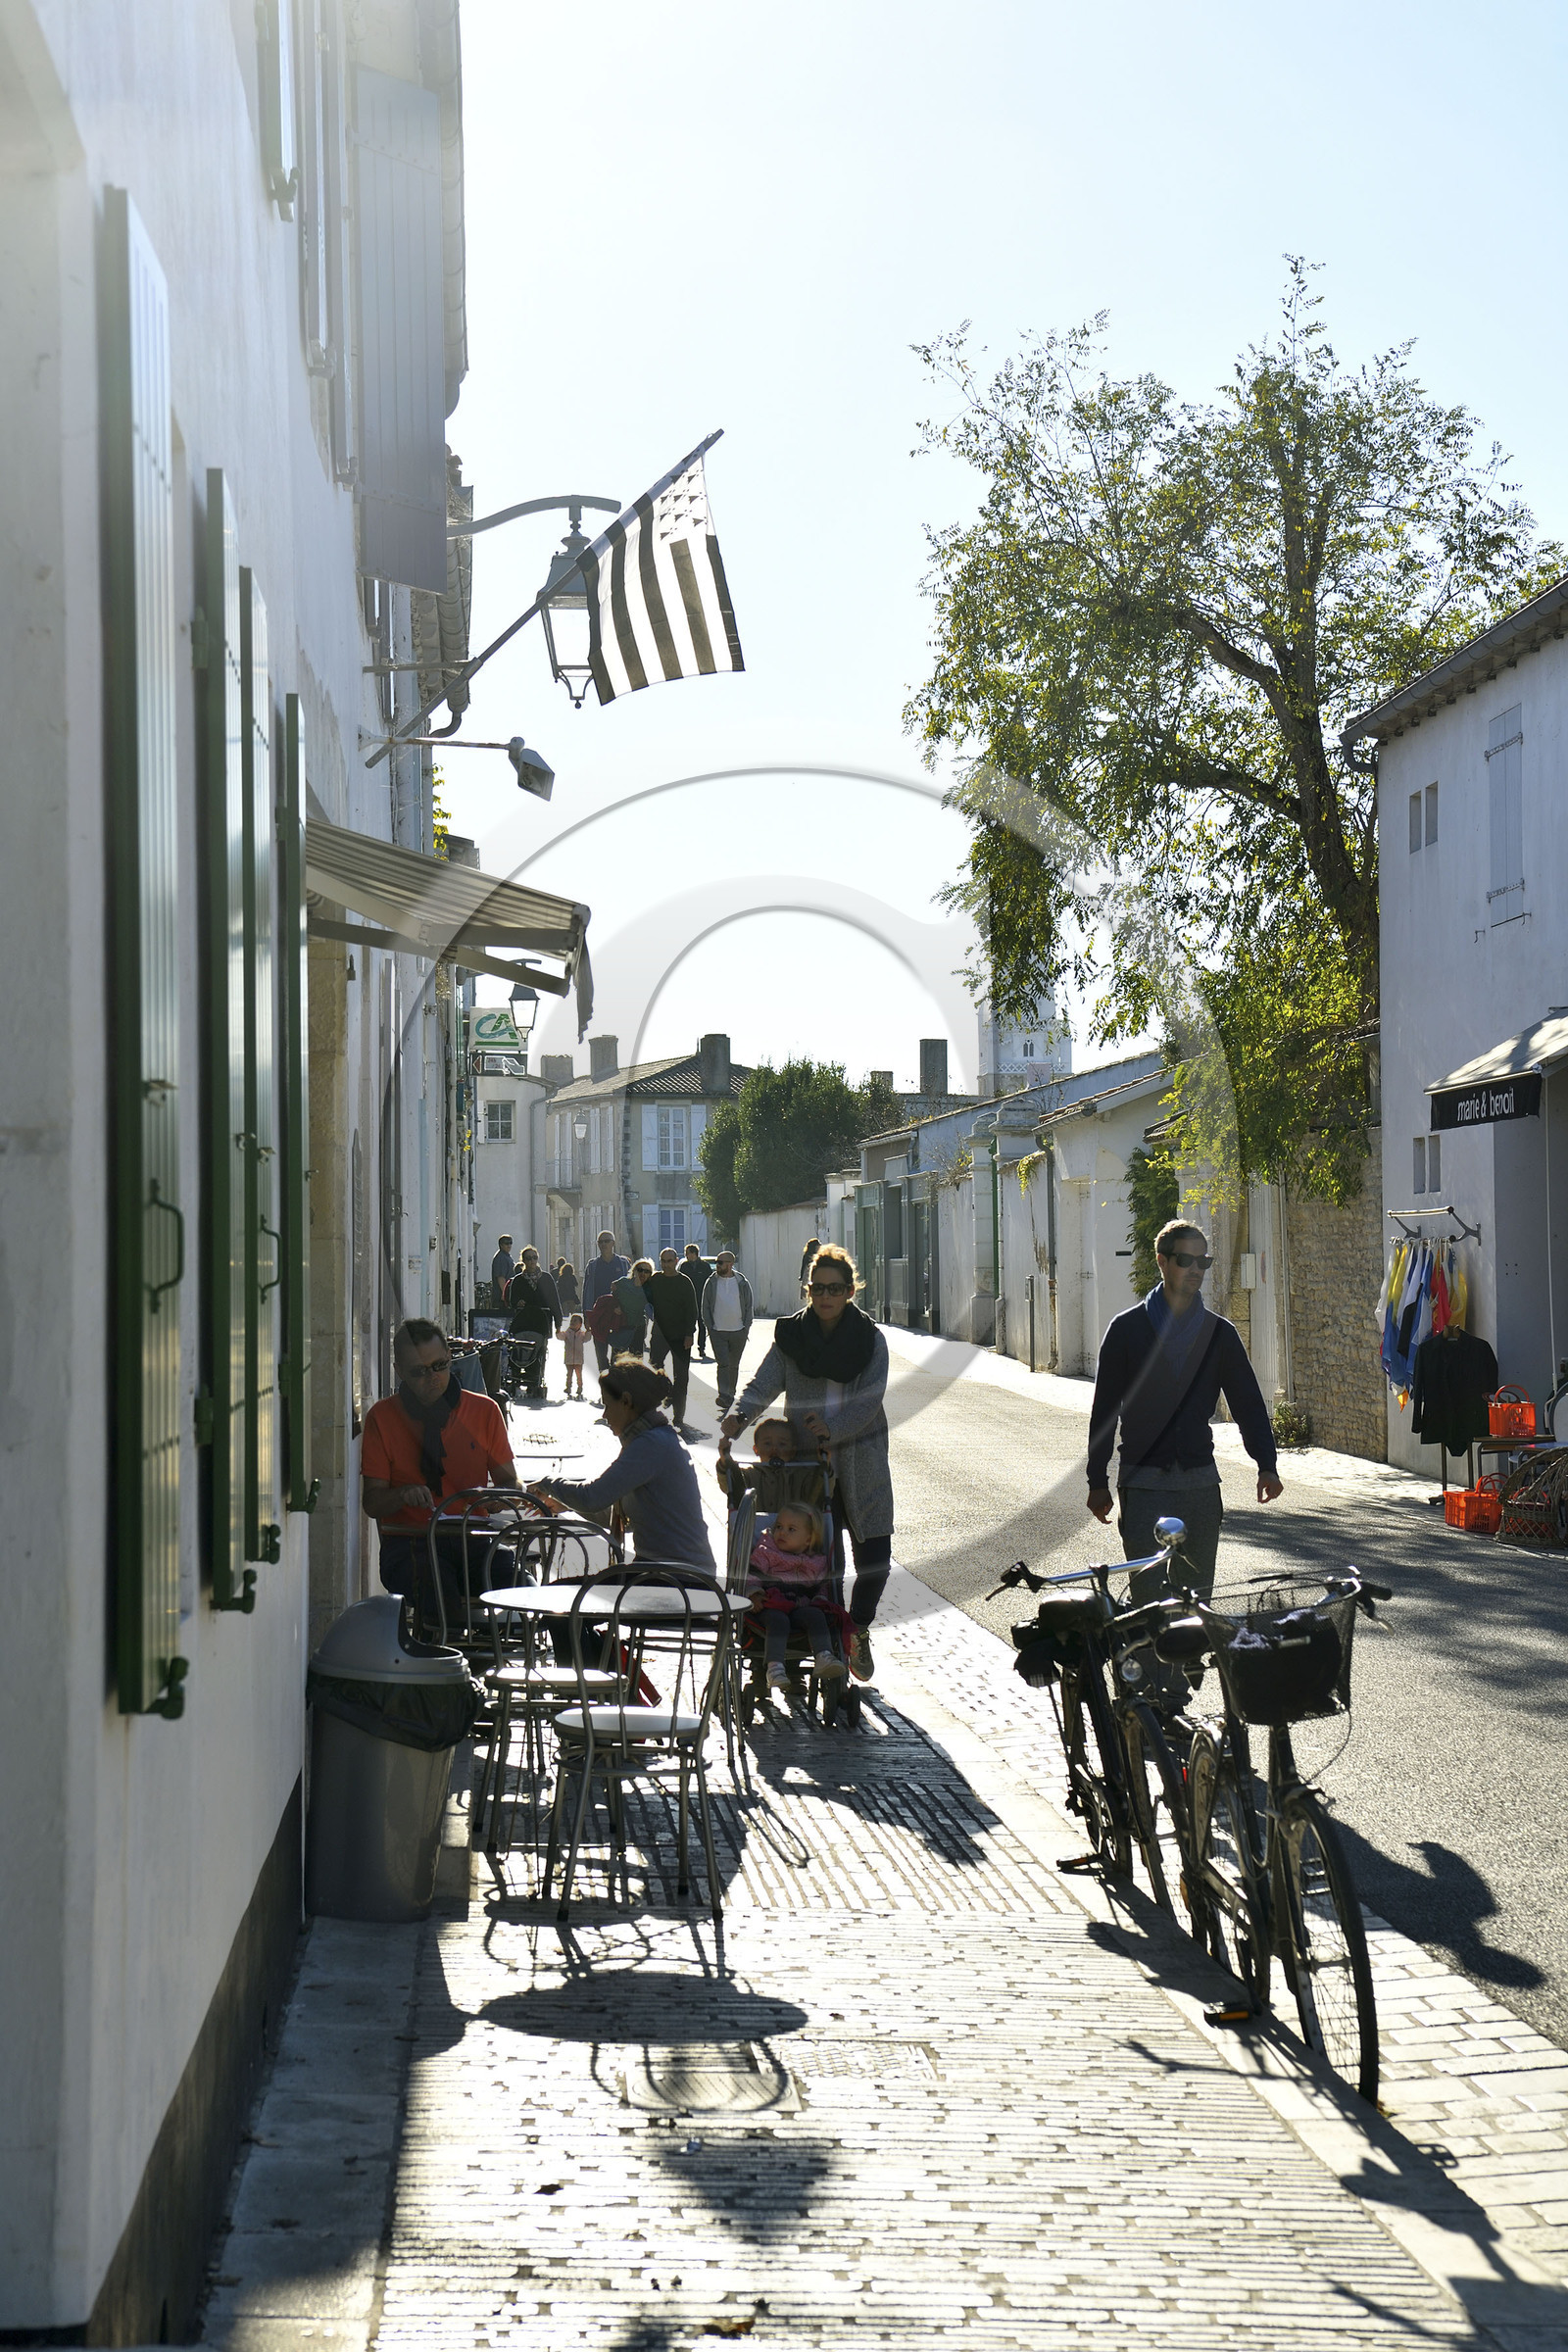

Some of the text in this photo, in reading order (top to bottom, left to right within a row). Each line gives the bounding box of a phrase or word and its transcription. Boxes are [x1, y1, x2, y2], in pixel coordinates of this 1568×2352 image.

[474, 1013, 518, 1039] CA
[1456, 1093, 1480, 1121] marie
[1480, 1090, 1488, 1118] &
